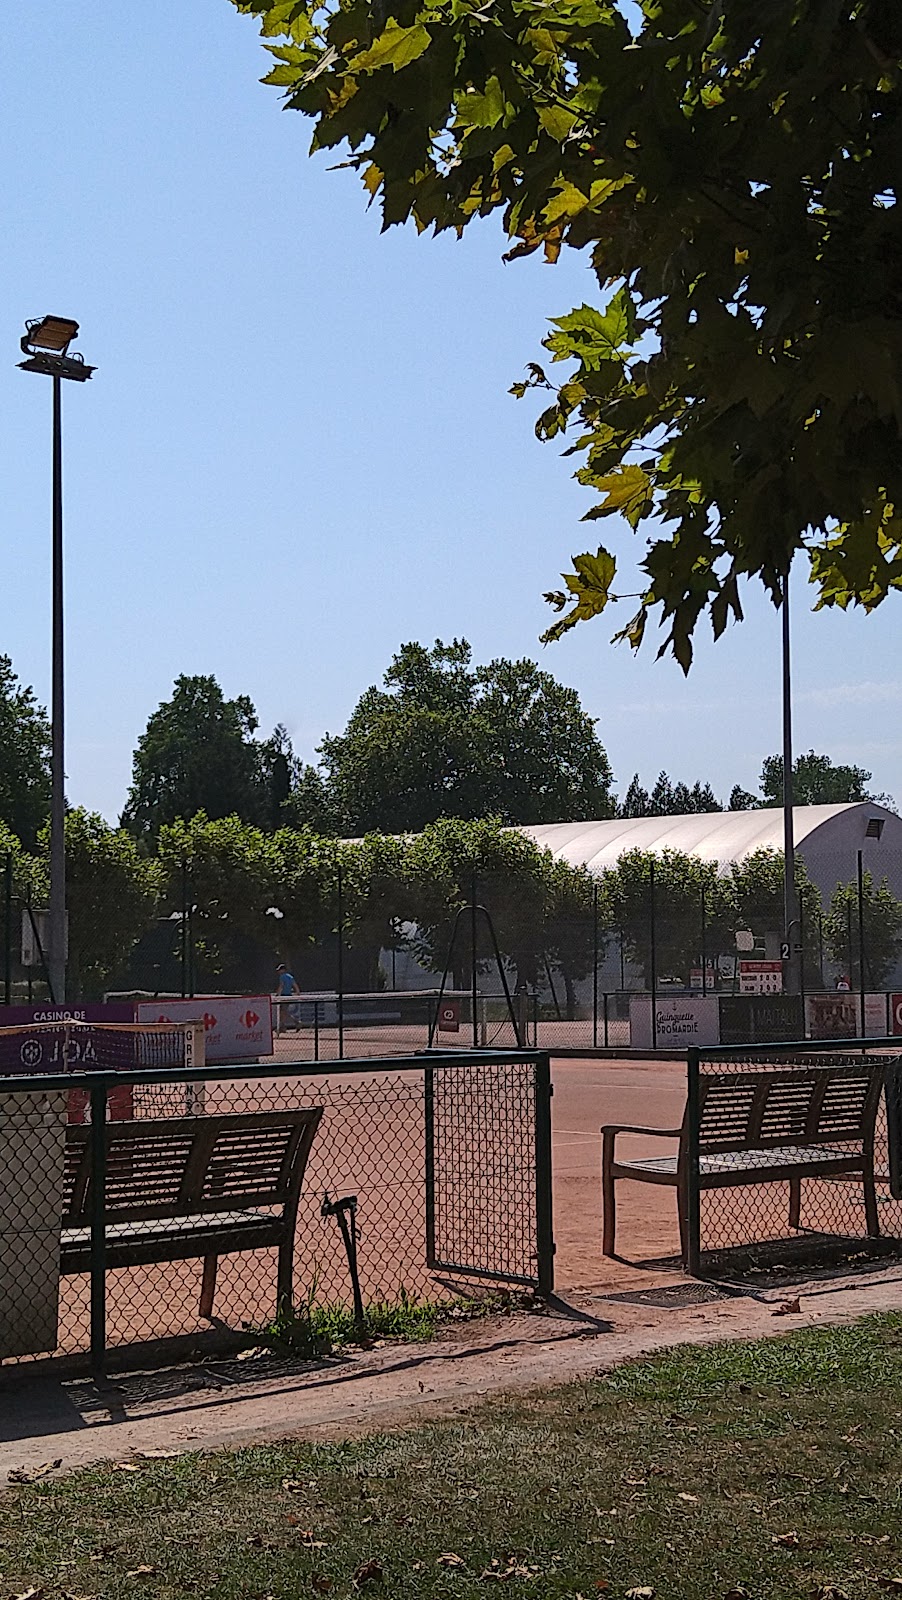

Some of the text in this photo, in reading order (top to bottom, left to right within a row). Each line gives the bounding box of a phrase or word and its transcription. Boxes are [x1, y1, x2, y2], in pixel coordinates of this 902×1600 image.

[781, 943, 789, 959] 2
[707, 958, 713, 968] 5
[33, 1011, 86, 1021] CASINO DE
[205, 1033, 221, 1044] rket
[235, 1031, 263, 1042] market
[48, 1038, 98, 1063] JOA
